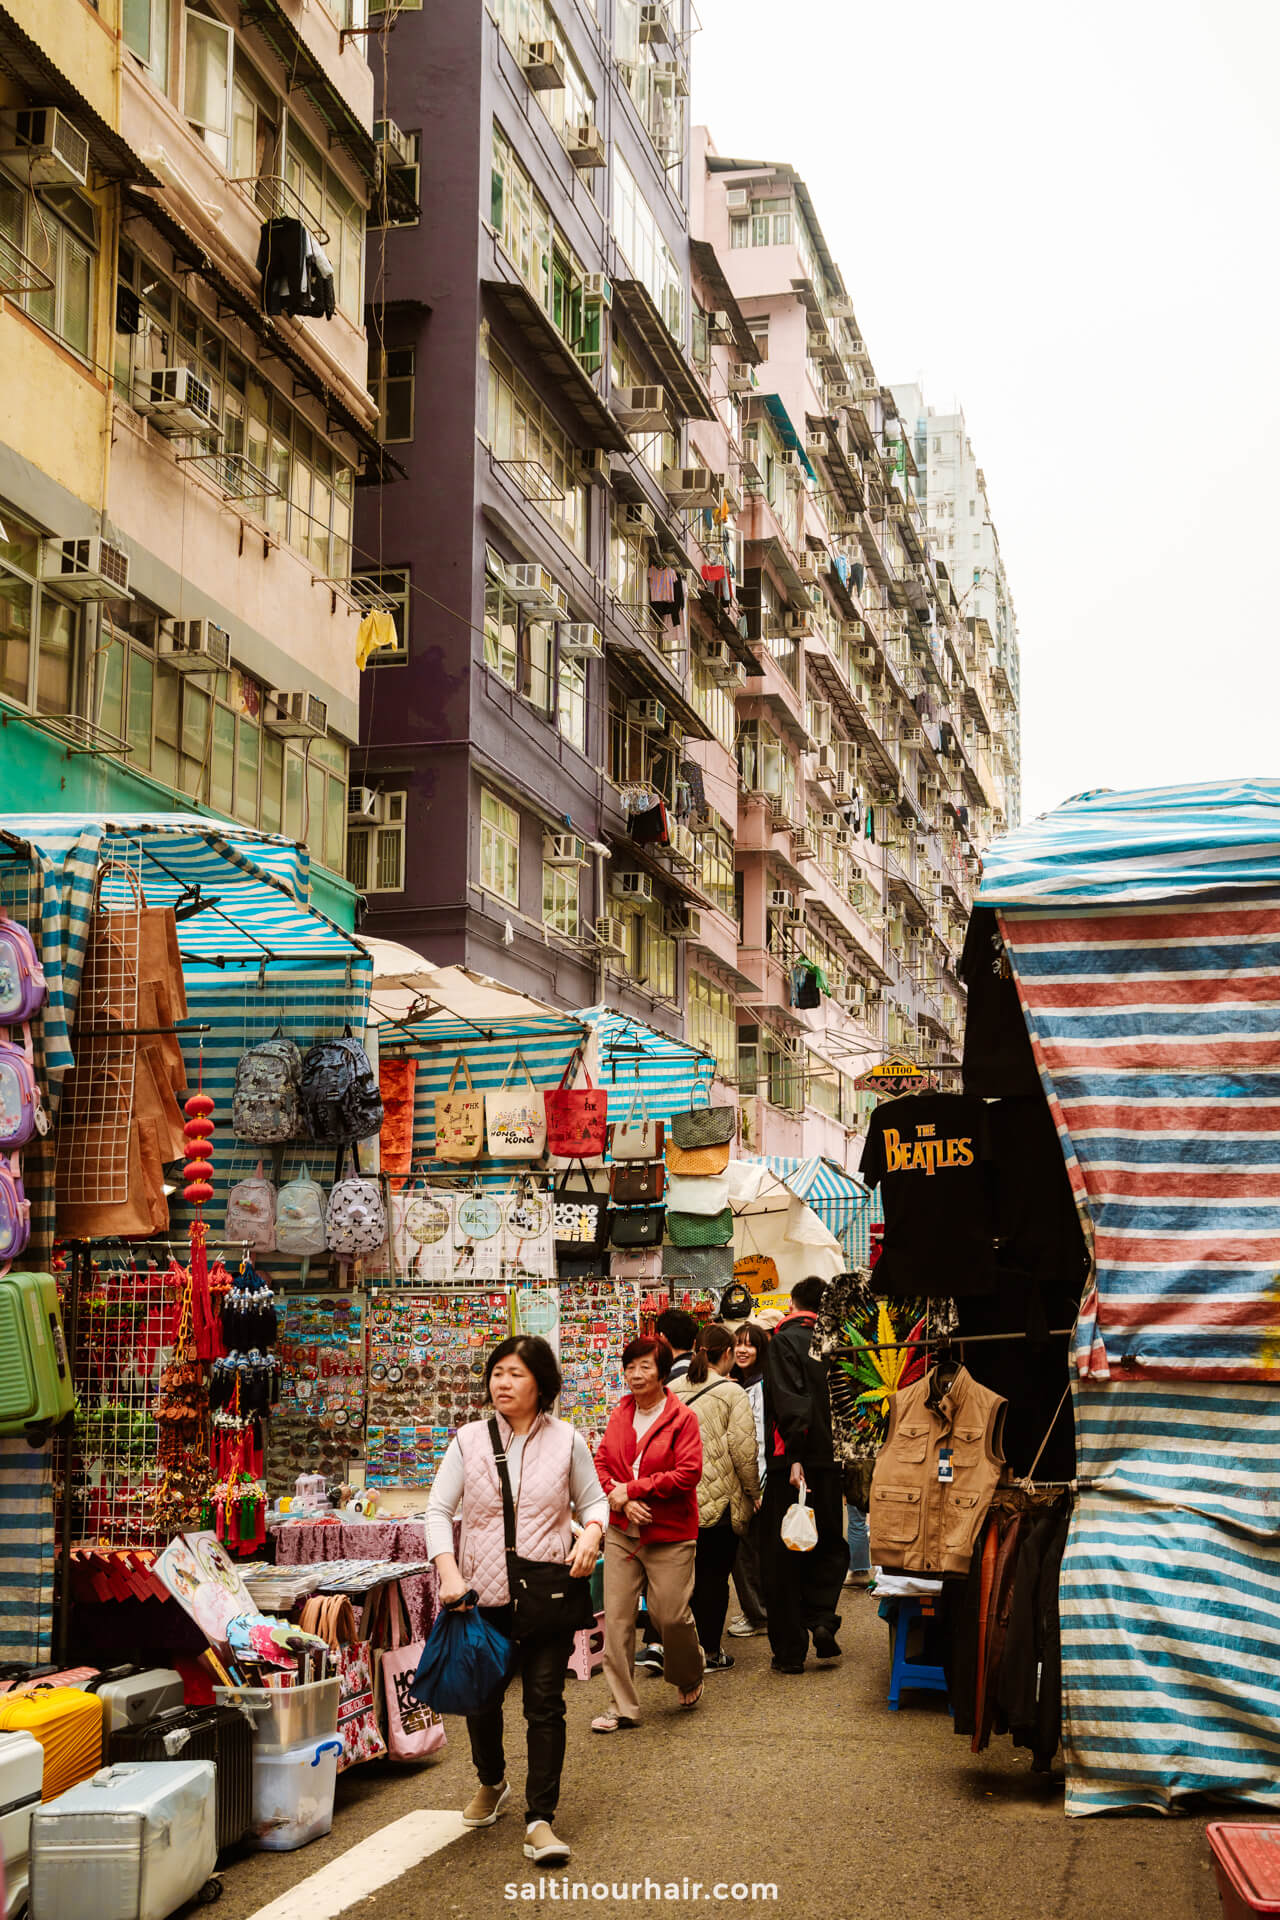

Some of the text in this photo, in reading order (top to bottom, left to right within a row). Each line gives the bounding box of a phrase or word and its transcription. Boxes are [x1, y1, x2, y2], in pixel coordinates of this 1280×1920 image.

[882, 1066, 913, 1075] TATTOO
[854, 1076, 938, 1091] BLACK ALTAR
[490, 1130, 517, 1138] HONG
[915, 1123, 936, 1137] THE
[505, 1136, 535, 1144] KONG
[882, 1128, 975, 1176] BEATLES
[553, 1202, 599, 1217] HONG
[553, 1214, 598, 1229] KONG
[393, 1668, 417, 1693] HO
[397, 1689, 427, 1713] KO
